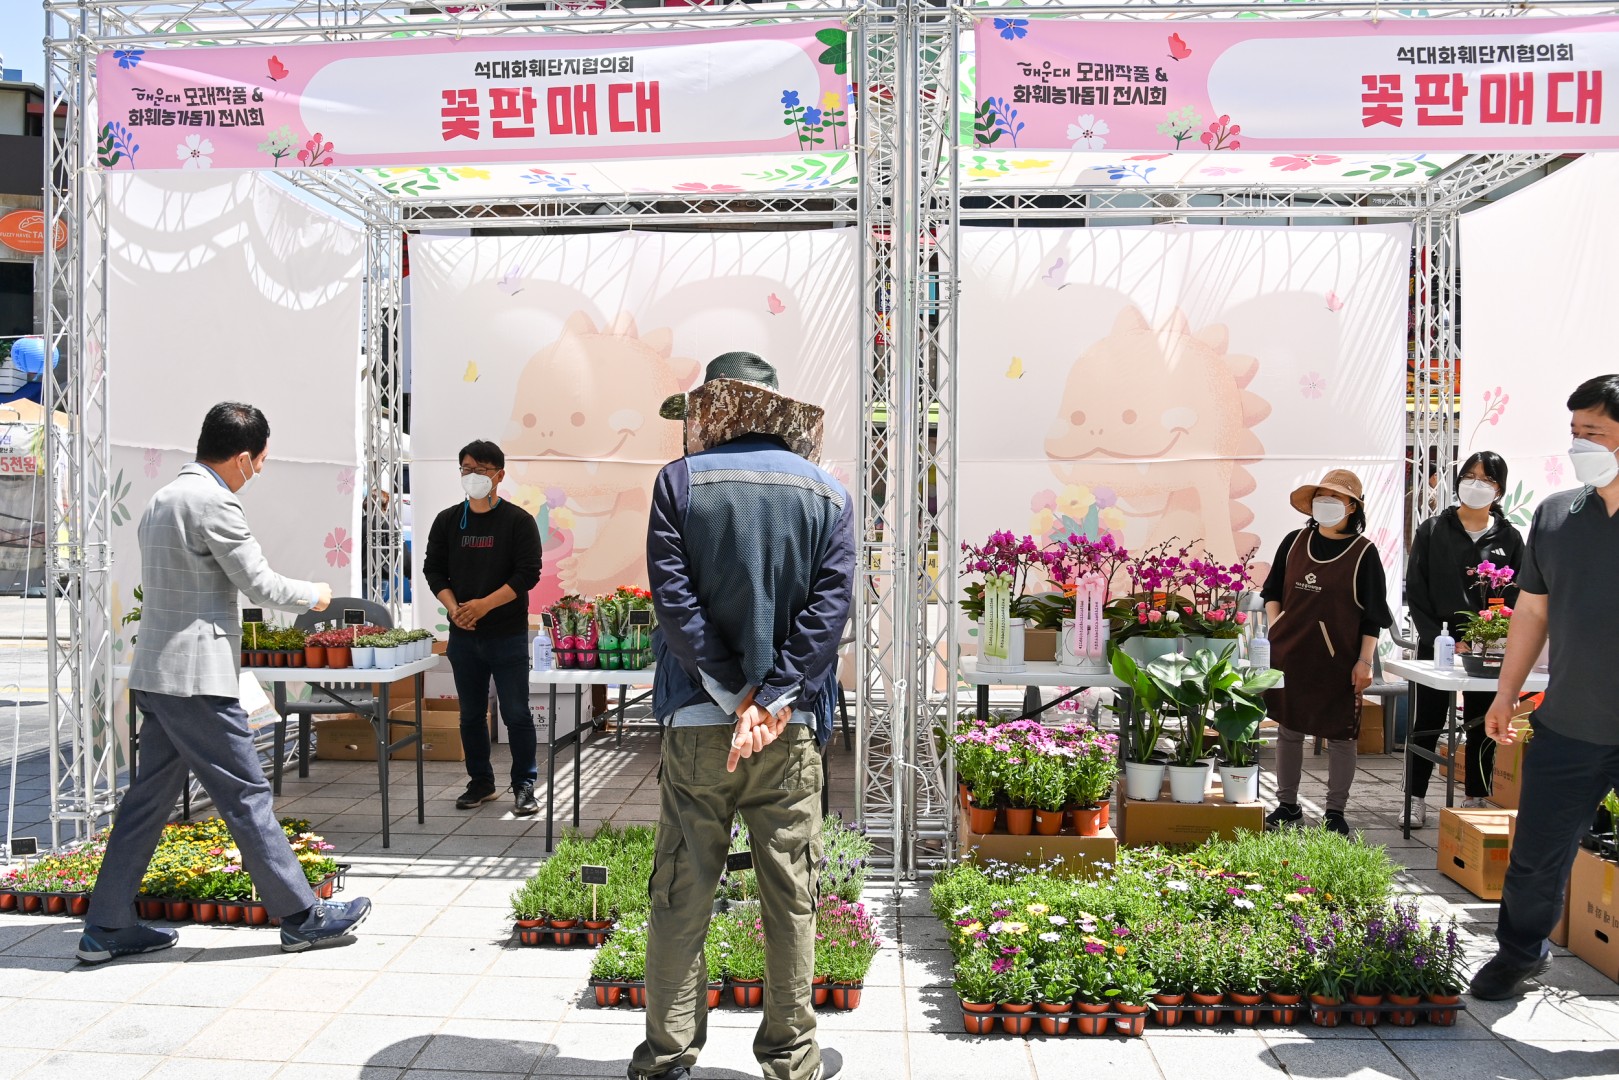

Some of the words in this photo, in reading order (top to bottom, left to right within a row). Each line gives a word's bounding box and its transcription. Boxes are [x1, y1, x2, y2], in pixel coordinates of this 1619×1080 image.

[1397, 43, 1574, 65] 석대화훼단지협의회
[474, 56, 634, 79] 석대화훼단지협의회
[1017, 60, 1071, 83] 해운대
[1076, 62, 1150, 82] 모래작품
[1155, 66, 1168, 82] &
[131, 87, 181, 106] 해운대
[183, 86, 247, 107] 모래작품
[251, 86, 264, 103] &
[1013, 85, 1109, 105] 화훼농가돕기
[1113, 85, 1167, 106] 전시회
[128, 108, 216, 127] 화훼농가돕기
[218, 107, 265, 128] 전시회
[1, 456, 36, 473] 5천원
[461, 536, 494, 548] PUMA
